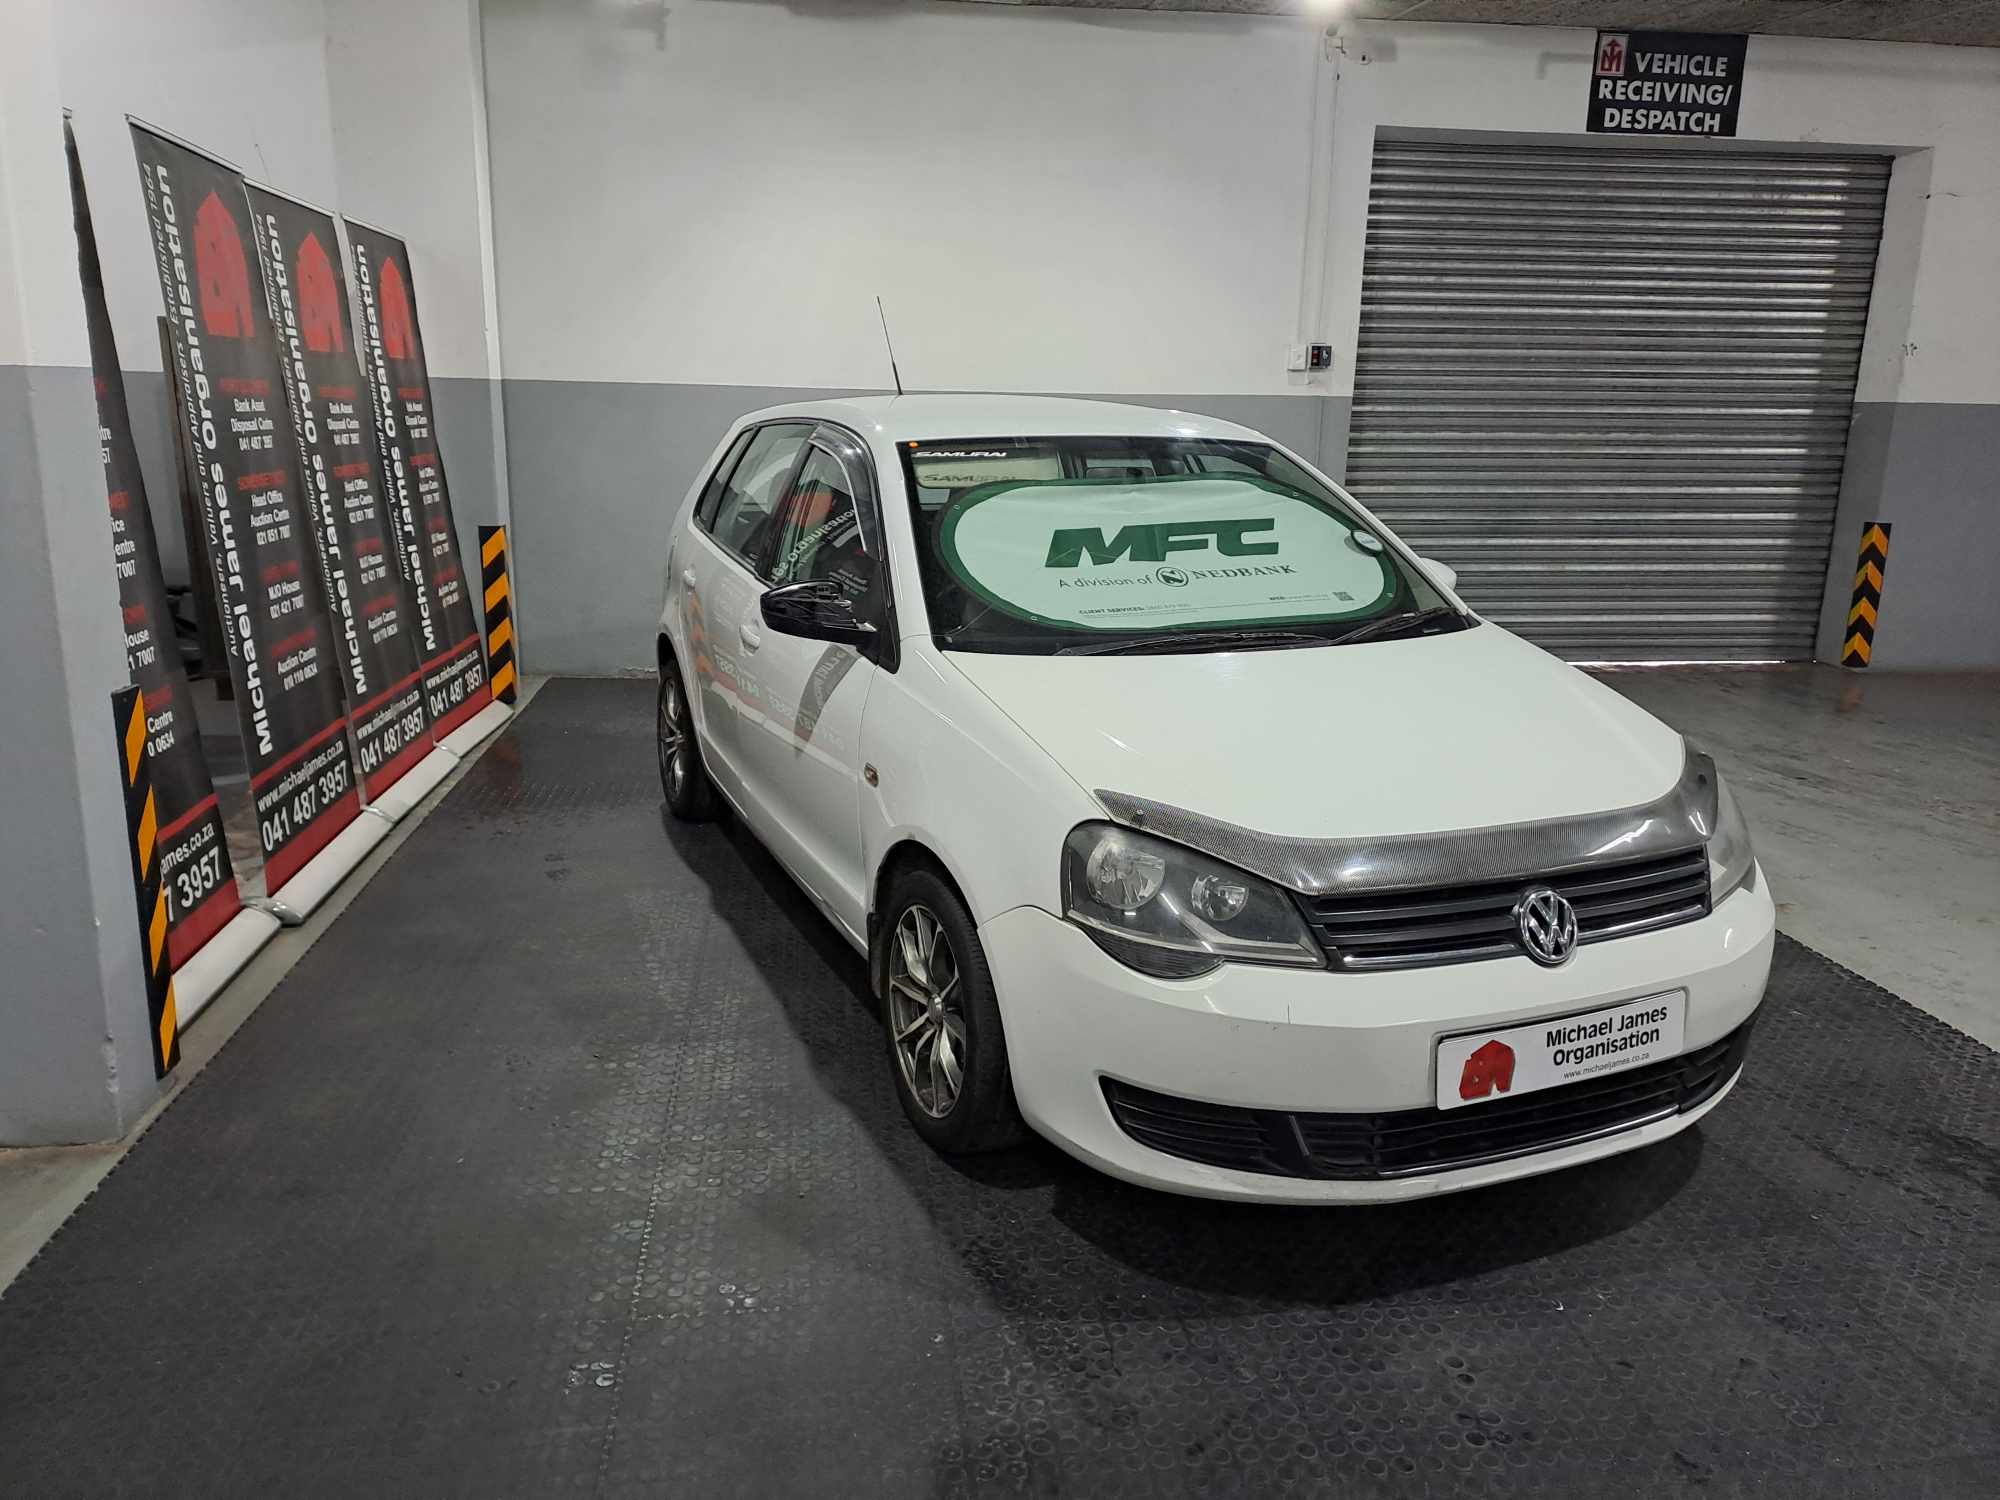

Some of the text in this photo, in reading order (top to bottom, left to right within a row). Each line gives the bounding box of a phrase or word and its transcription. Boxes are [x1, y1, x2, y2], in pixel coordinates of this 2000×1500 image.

[1634, 52, 1728, 78] VEHICLE
[1598, 80, 1734, 107] RECEIVING/
[1603, 107, 1721, 133] DESPATCH
[142, 162, 158, 210] 1964
[151, 215, 180, 324] Established
[356, 244, 396, 438] Organisation
[176, 341, 200, 438] Appraisers
[156, 164, 273, 757] Michael James Organisation
[192, 441, 207, 476] and
[266, 213, 367, 695] Michael James Organisation
[201, 481, 219, 545] Valuers
[390, 446, 415, 537] James
[1045, 517, 1280, 568] MFC
[407, 544, 436, 650] Michael
[1058, 564, 1297, 589] A division of NEDBANK
[136, 646, 156, 668] 7007
[430, 664, 482, 717] 041 487 3957
[147, 709, 174, 734] Centre
[360, 706, 424, 773] 041 487 3957
[262, 760, 348, 851] 041 487 3957
[177, 846, 222, 909] 3957
[1546, 1006, 1668, 1048] Michael James
[1552, 1028, 1660, 1066] Organisation
